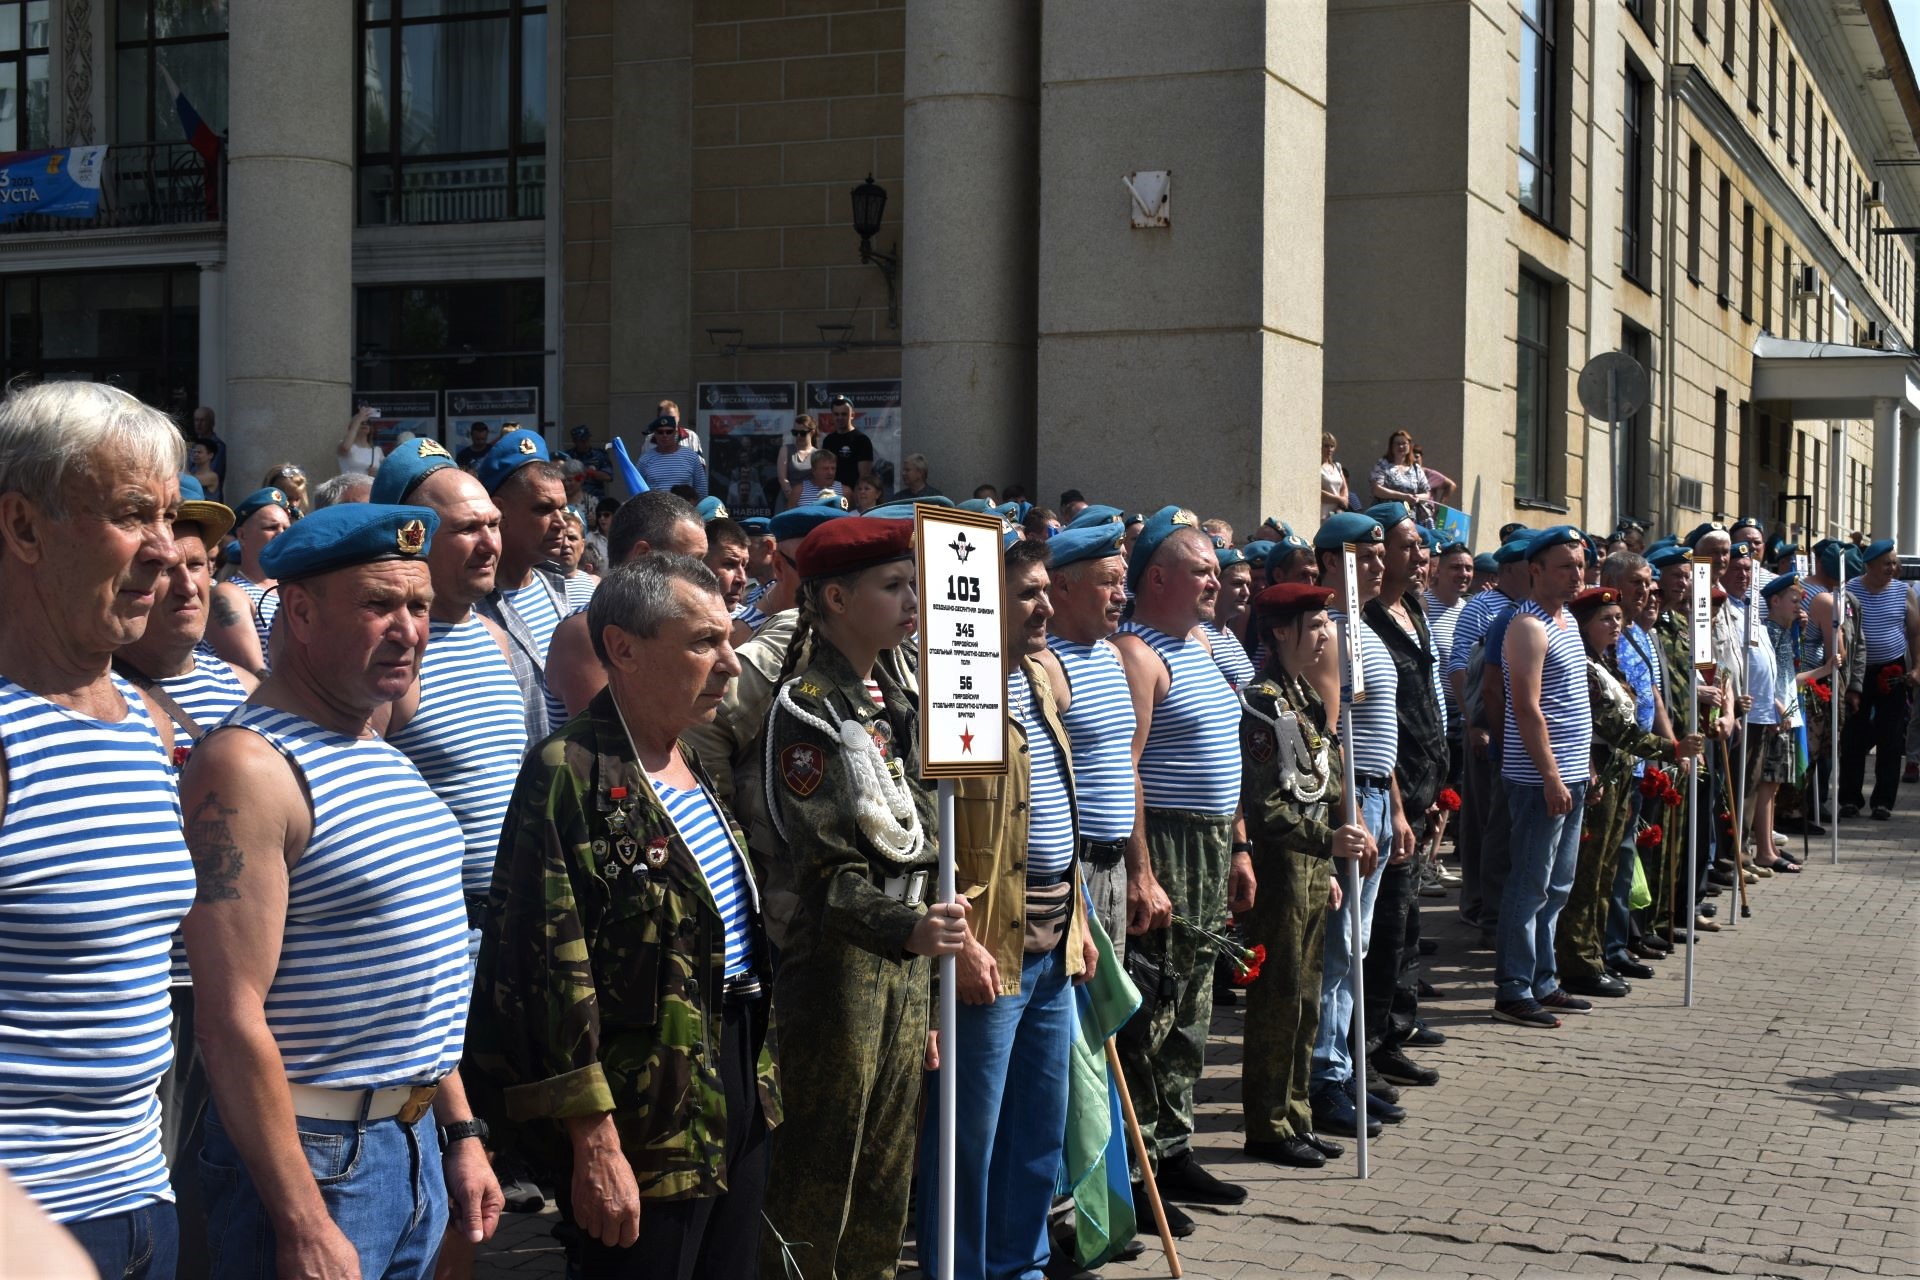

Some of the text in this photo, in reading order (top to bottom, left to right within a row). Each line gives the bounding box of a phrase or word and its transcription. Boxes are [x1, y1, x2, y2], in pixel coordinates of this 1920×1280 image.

[947, 575, 980, 602] 103
[933, 604, 976, 613] ВОЗДУШНО-ДЕСАНТНАЯ
[956, 622, 974, 638] 345
[960, 676, 972, 690] 56
[624, 846, 632, 856] 3
